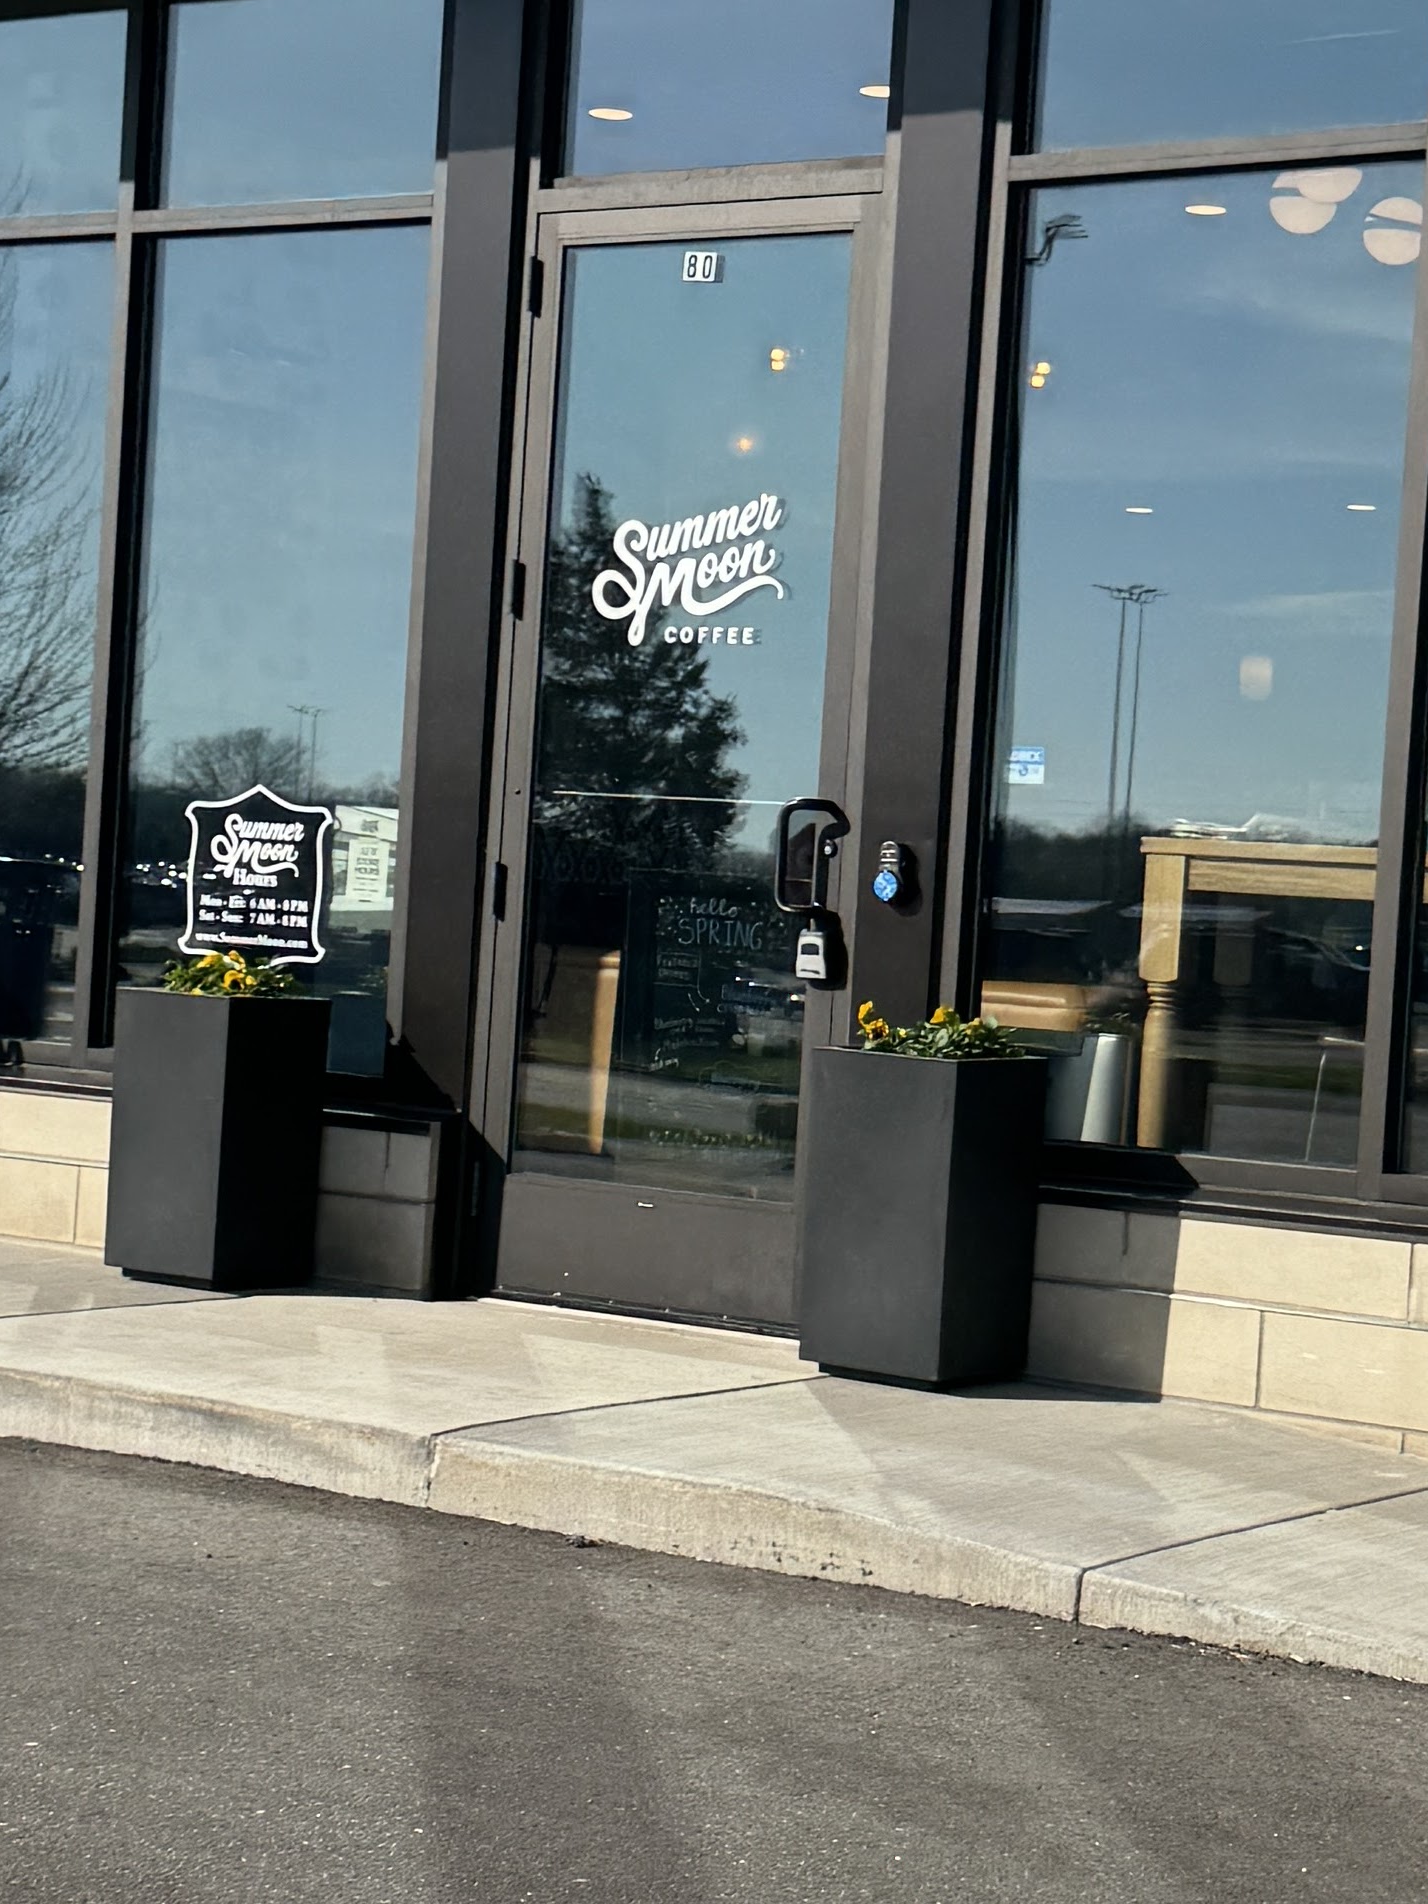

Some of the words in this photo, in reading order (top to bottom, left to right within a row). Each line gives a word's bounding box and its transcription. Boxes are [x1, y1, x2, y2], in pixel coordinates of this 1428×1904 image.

[687, 254, 713, 279] 80
[592, 493, 782, 620] Summer
[628, 539, 784, 646] Moon
[664, 626, 755, 645] COFFEE
[211, 813, 305, 864] Summer
[223, 839, 299, 878] Moon
[257, 898, 276, 910] AM
[290, 900, 309, 912] PM
[690, 896, 741, 918] hello
[249, 912, 257, 924] 7
[257, 913, 276, 925] AM
[289, 915, 308, 928] PM
[678, 917, 764, 950] SPRING
